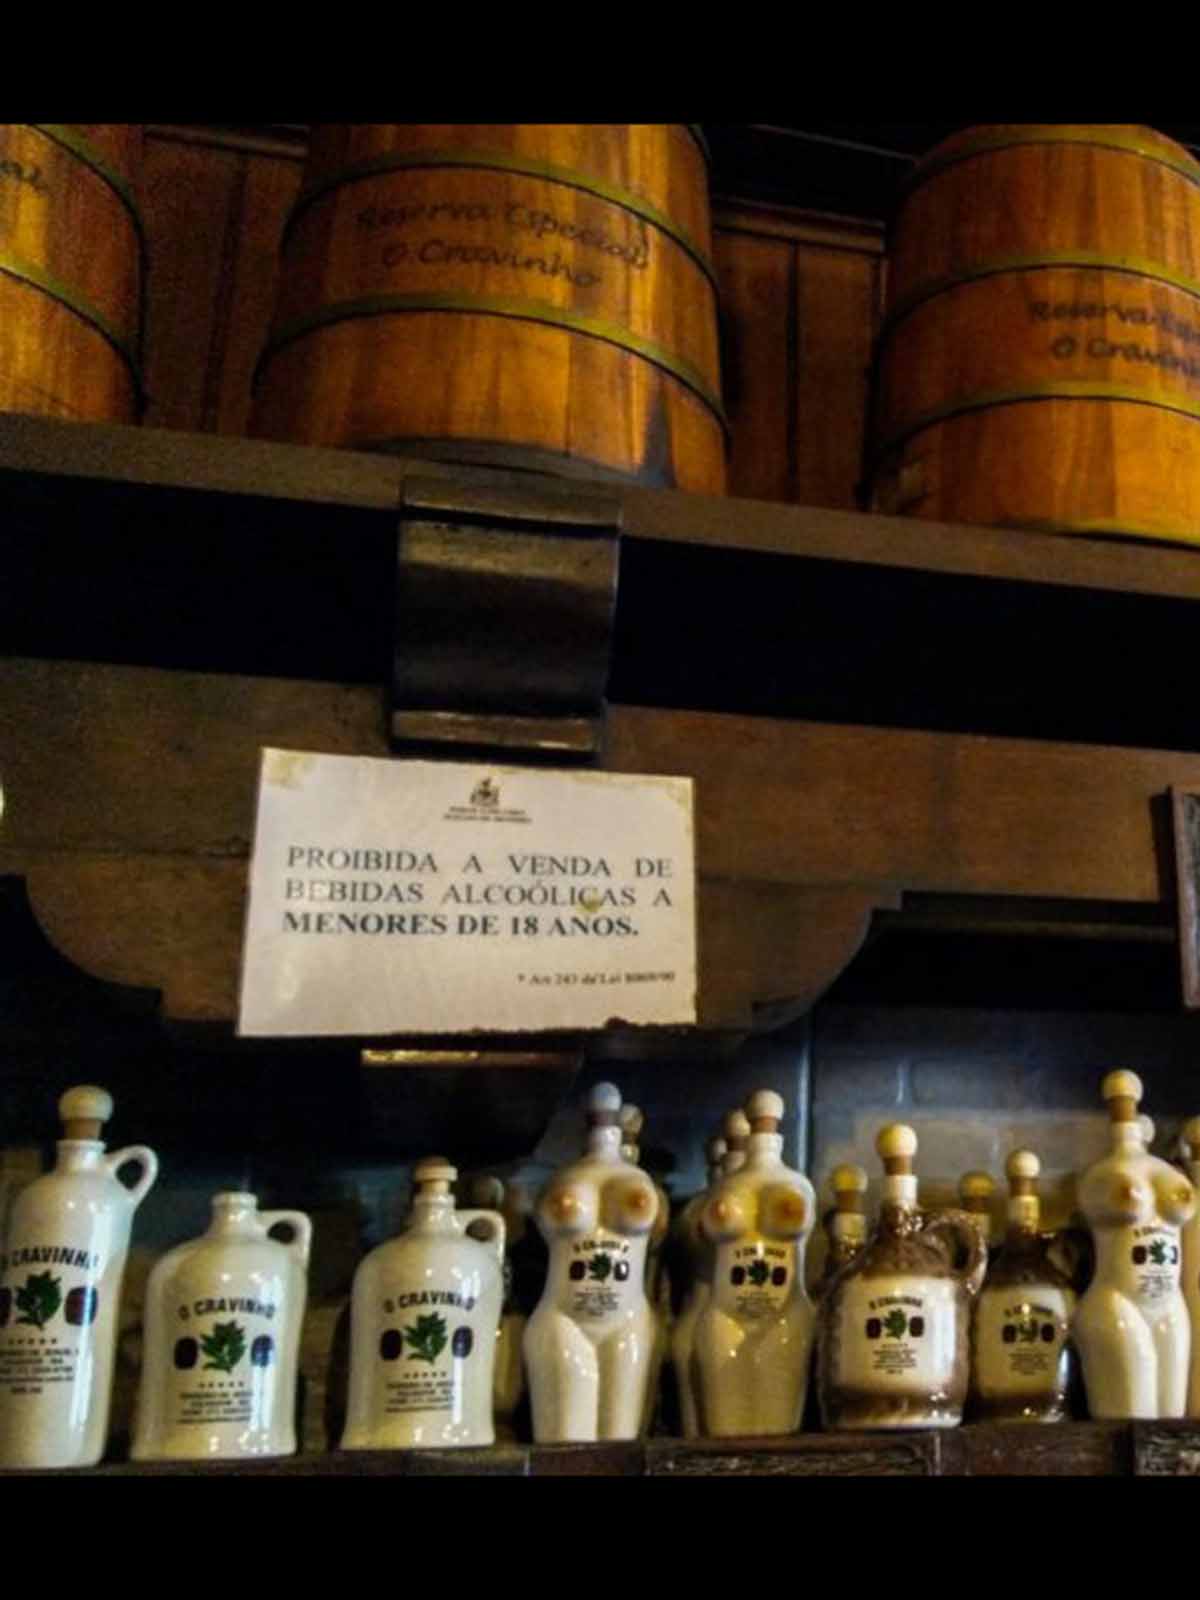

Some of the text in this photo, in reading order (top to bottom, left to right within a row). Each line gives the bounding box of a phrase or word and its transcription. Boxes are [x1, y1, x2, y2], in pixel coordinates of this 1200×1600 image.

[286, 845, 673, 879] PROIBIDA A VENDA DE
[284, 877, 673, 908] BEBIDAS ALCOÓLICAS A
[282, 911, 448, 936] MENORES
[456, 912, 500, 937] DE
[510, 916, 540, 937] 18
